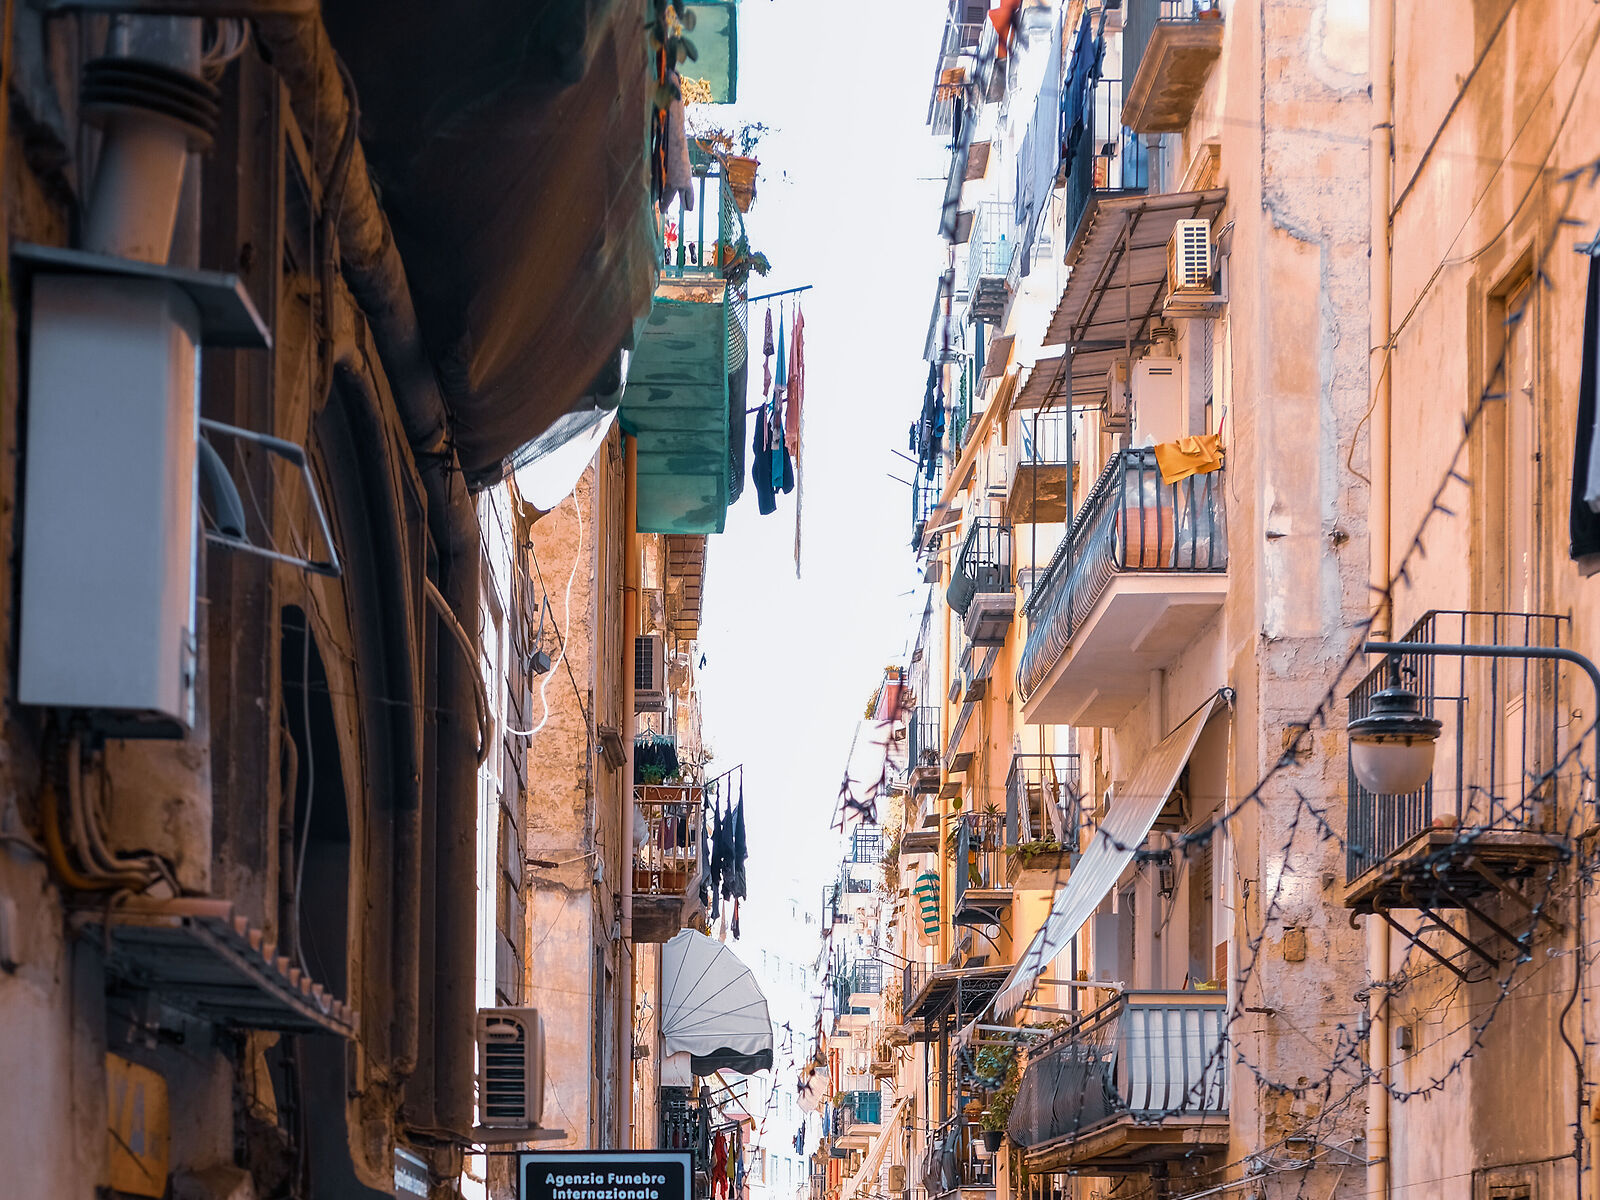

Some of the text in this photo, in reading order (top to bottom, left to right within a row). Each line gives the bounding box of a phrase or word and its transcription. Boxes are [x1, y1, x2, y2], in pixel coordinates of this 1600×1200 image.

[545, 1173, 666, 1187] Agenzia Funebre
[553, 1188, 659, 1200] Internazionale
